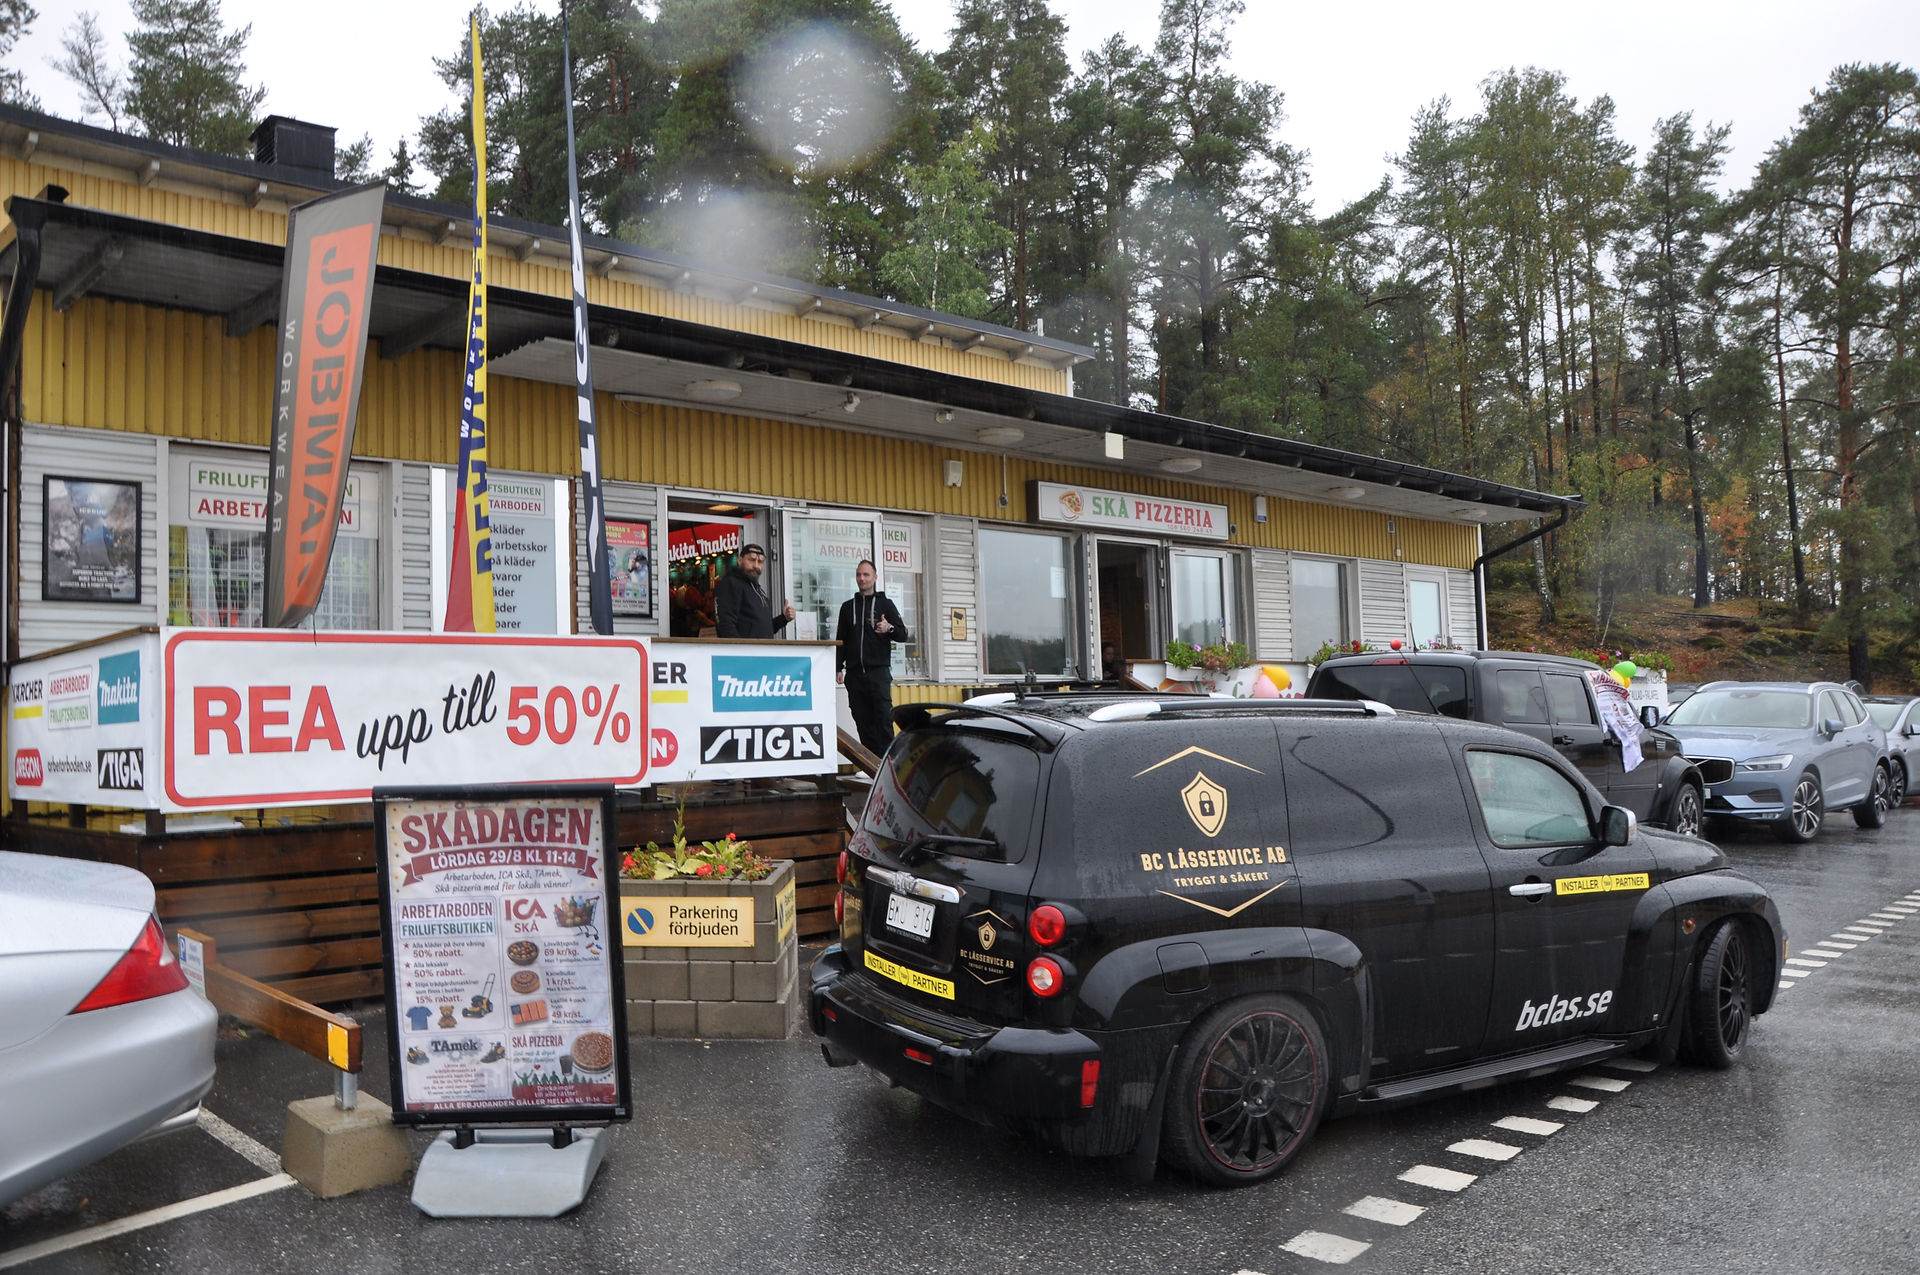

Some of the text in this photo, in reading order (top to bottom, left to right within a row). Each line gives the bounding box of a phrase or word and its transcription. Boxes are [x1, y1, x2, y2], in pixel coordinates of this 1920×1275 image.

[272, 319, 296, 533] WORKWEAR
[1092, 495, 1213, 528] SKÅ PIZZERIA
[495, 541, 548, 552] arbetsskor
[504, 556, 536, 568] kläder
[50, 674, 90, 697] ARBETARBODEN
[194, 670, 631, 772] REA upp till 50%
[704, 727, 820, 762] STIGA
[48, 755, 92, 774] arbetarboden.se
[99, 750, 142, 788] STIGA
[401, 801, 594, 854] SKÅDAGEN
[430, 850, 576, 870] LÖRDAG 29/8 KL 11-14
[1140, 846, 1286, 872] BC LÅSSERVICE AB
[452, 884, 482, 894] pizzeria
[484, 881, 500, 892] med
[1174, 872, 1269, 888] TRYGGT & SÄKERT
[1562, 880, 1599, 892] INSTALLER
[1616, 876, 1645, 888] PARTNER
[402, 902, 492, 919] ARBETARBODEN
[504, 898, 548, 920] ICA
[669, 905, 738, 922] Parkering
[402, 922, 494, 936] FRILUFTSBUTIKEN
[514, 920, 540, 934] SKÅ
[668, 922, 738, 938] förbjuden
[413, 949, 464, 958] 50% rabatt.
[544, 949, 555, 957] 69
[968, 950, 1004, 967] LÅSSERVICE
[1006, 960, 1014, 968] AB
[414, 970, 434, 978] 50%
[868, 955, 896, 977] INSTALLER
[912, 974, 948, 995] PARTNER
[416, 996, 433, 1004] 15%
[1515, 990, 1613, 1032] bclas.se
[430, 1039, 478, 1052] TAmek
[512, 1034, 564, 1048] SKÅ PIZZERIA
